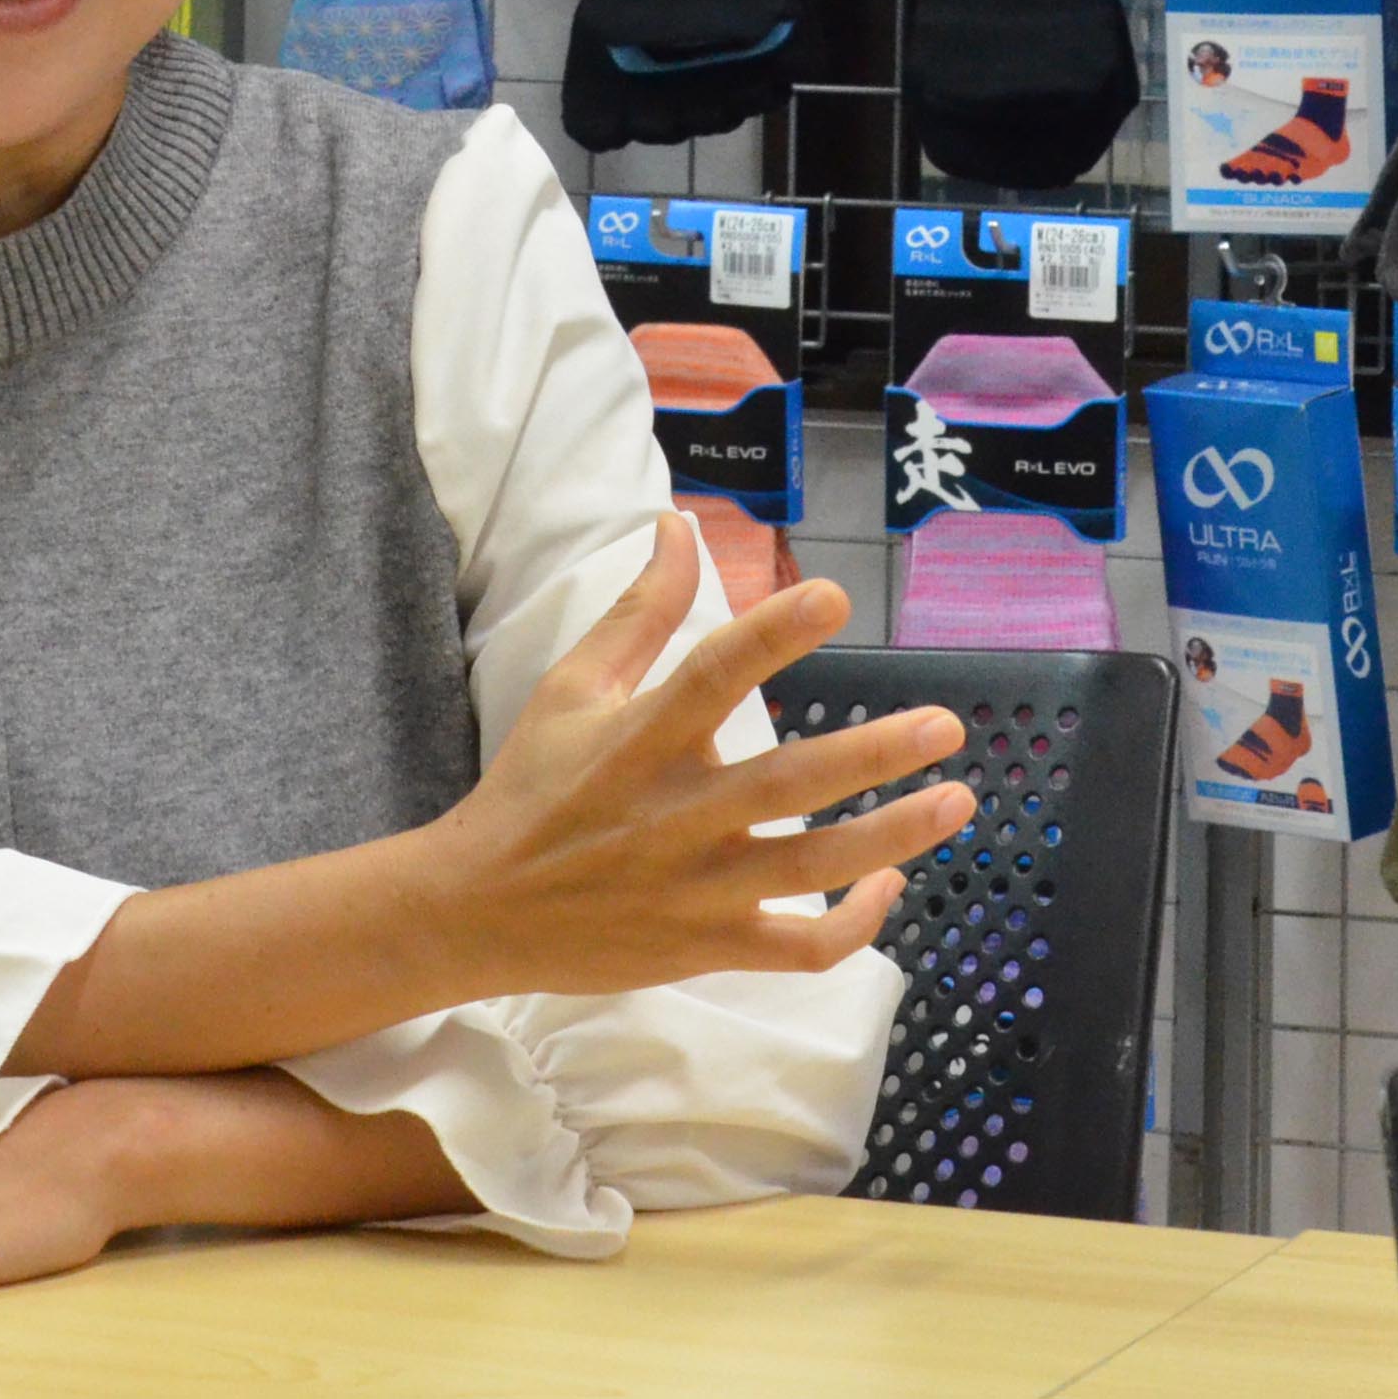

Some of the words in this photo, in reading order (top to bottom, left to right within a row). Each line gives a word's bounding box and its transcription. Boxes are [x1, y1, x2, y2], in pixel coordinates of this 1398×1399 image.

[726, 445, 768, 461] EVO
[894, 400, 982, 513] 走
[1054, 461, 1097, 477] EVO
[1189, 521, 1282, 553] ULTRA
